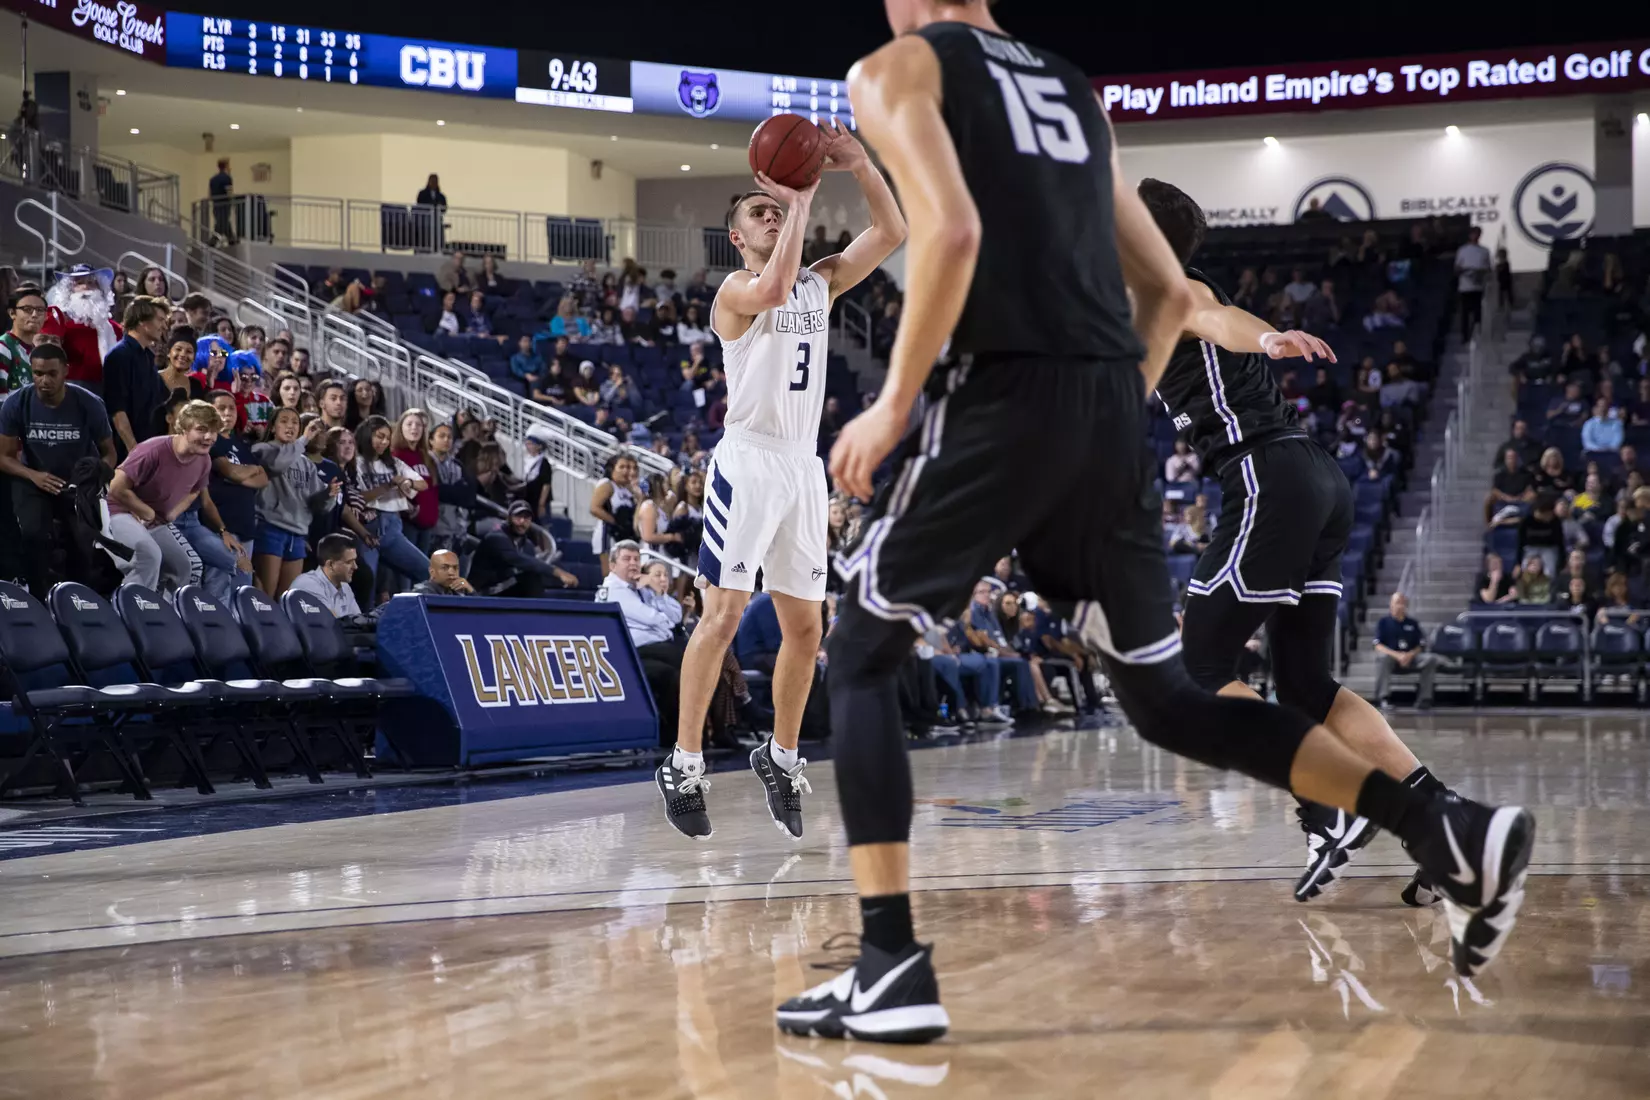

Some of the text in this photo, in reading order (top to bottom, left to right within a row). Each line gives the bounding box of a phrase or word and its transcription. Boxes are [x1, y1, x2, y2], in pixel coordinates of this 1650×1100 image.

[72, 0, 164, 46] Goose Creek
[93, 23, 144, 54] GOLF CLUB
[203, 17, 232, 35] PLYR
[271, 25, 285, 42] 15
[296, 28, 310, 45] 31
[320, 31, 336, 48] 33
[345, 33, 361, 50] 35
[203, 35, 225, 52] PTS
[274, 43, 282, 60] 2
[324, 49, 333, 65] 2
[203, 52, 226, 70] FLS
[249, 58, 257, 75] 2
[324, 66, 331, 82] 1
[400, 44, 486, 91] CBU
[549, 58, 598, 93] 9:43
[1103, 84, 1164, 115] Play
[1170, 76, 1259, 107] Inland
[1265, 67, 1394, 104] Empire's
[1400, 64, 1460, 96] Top
[1467, 55, 1557, 88] Rated
[1564, 49, 1632, 81] Golf
[985, 59, 1090, 165] 15
[1400, 194, 1499, 212] BIBLICALLY
[789, 342, 811, 391] 3
[27, 429, 80, 440] ANCERS
[455, 635, 625, 708] LANCERS
